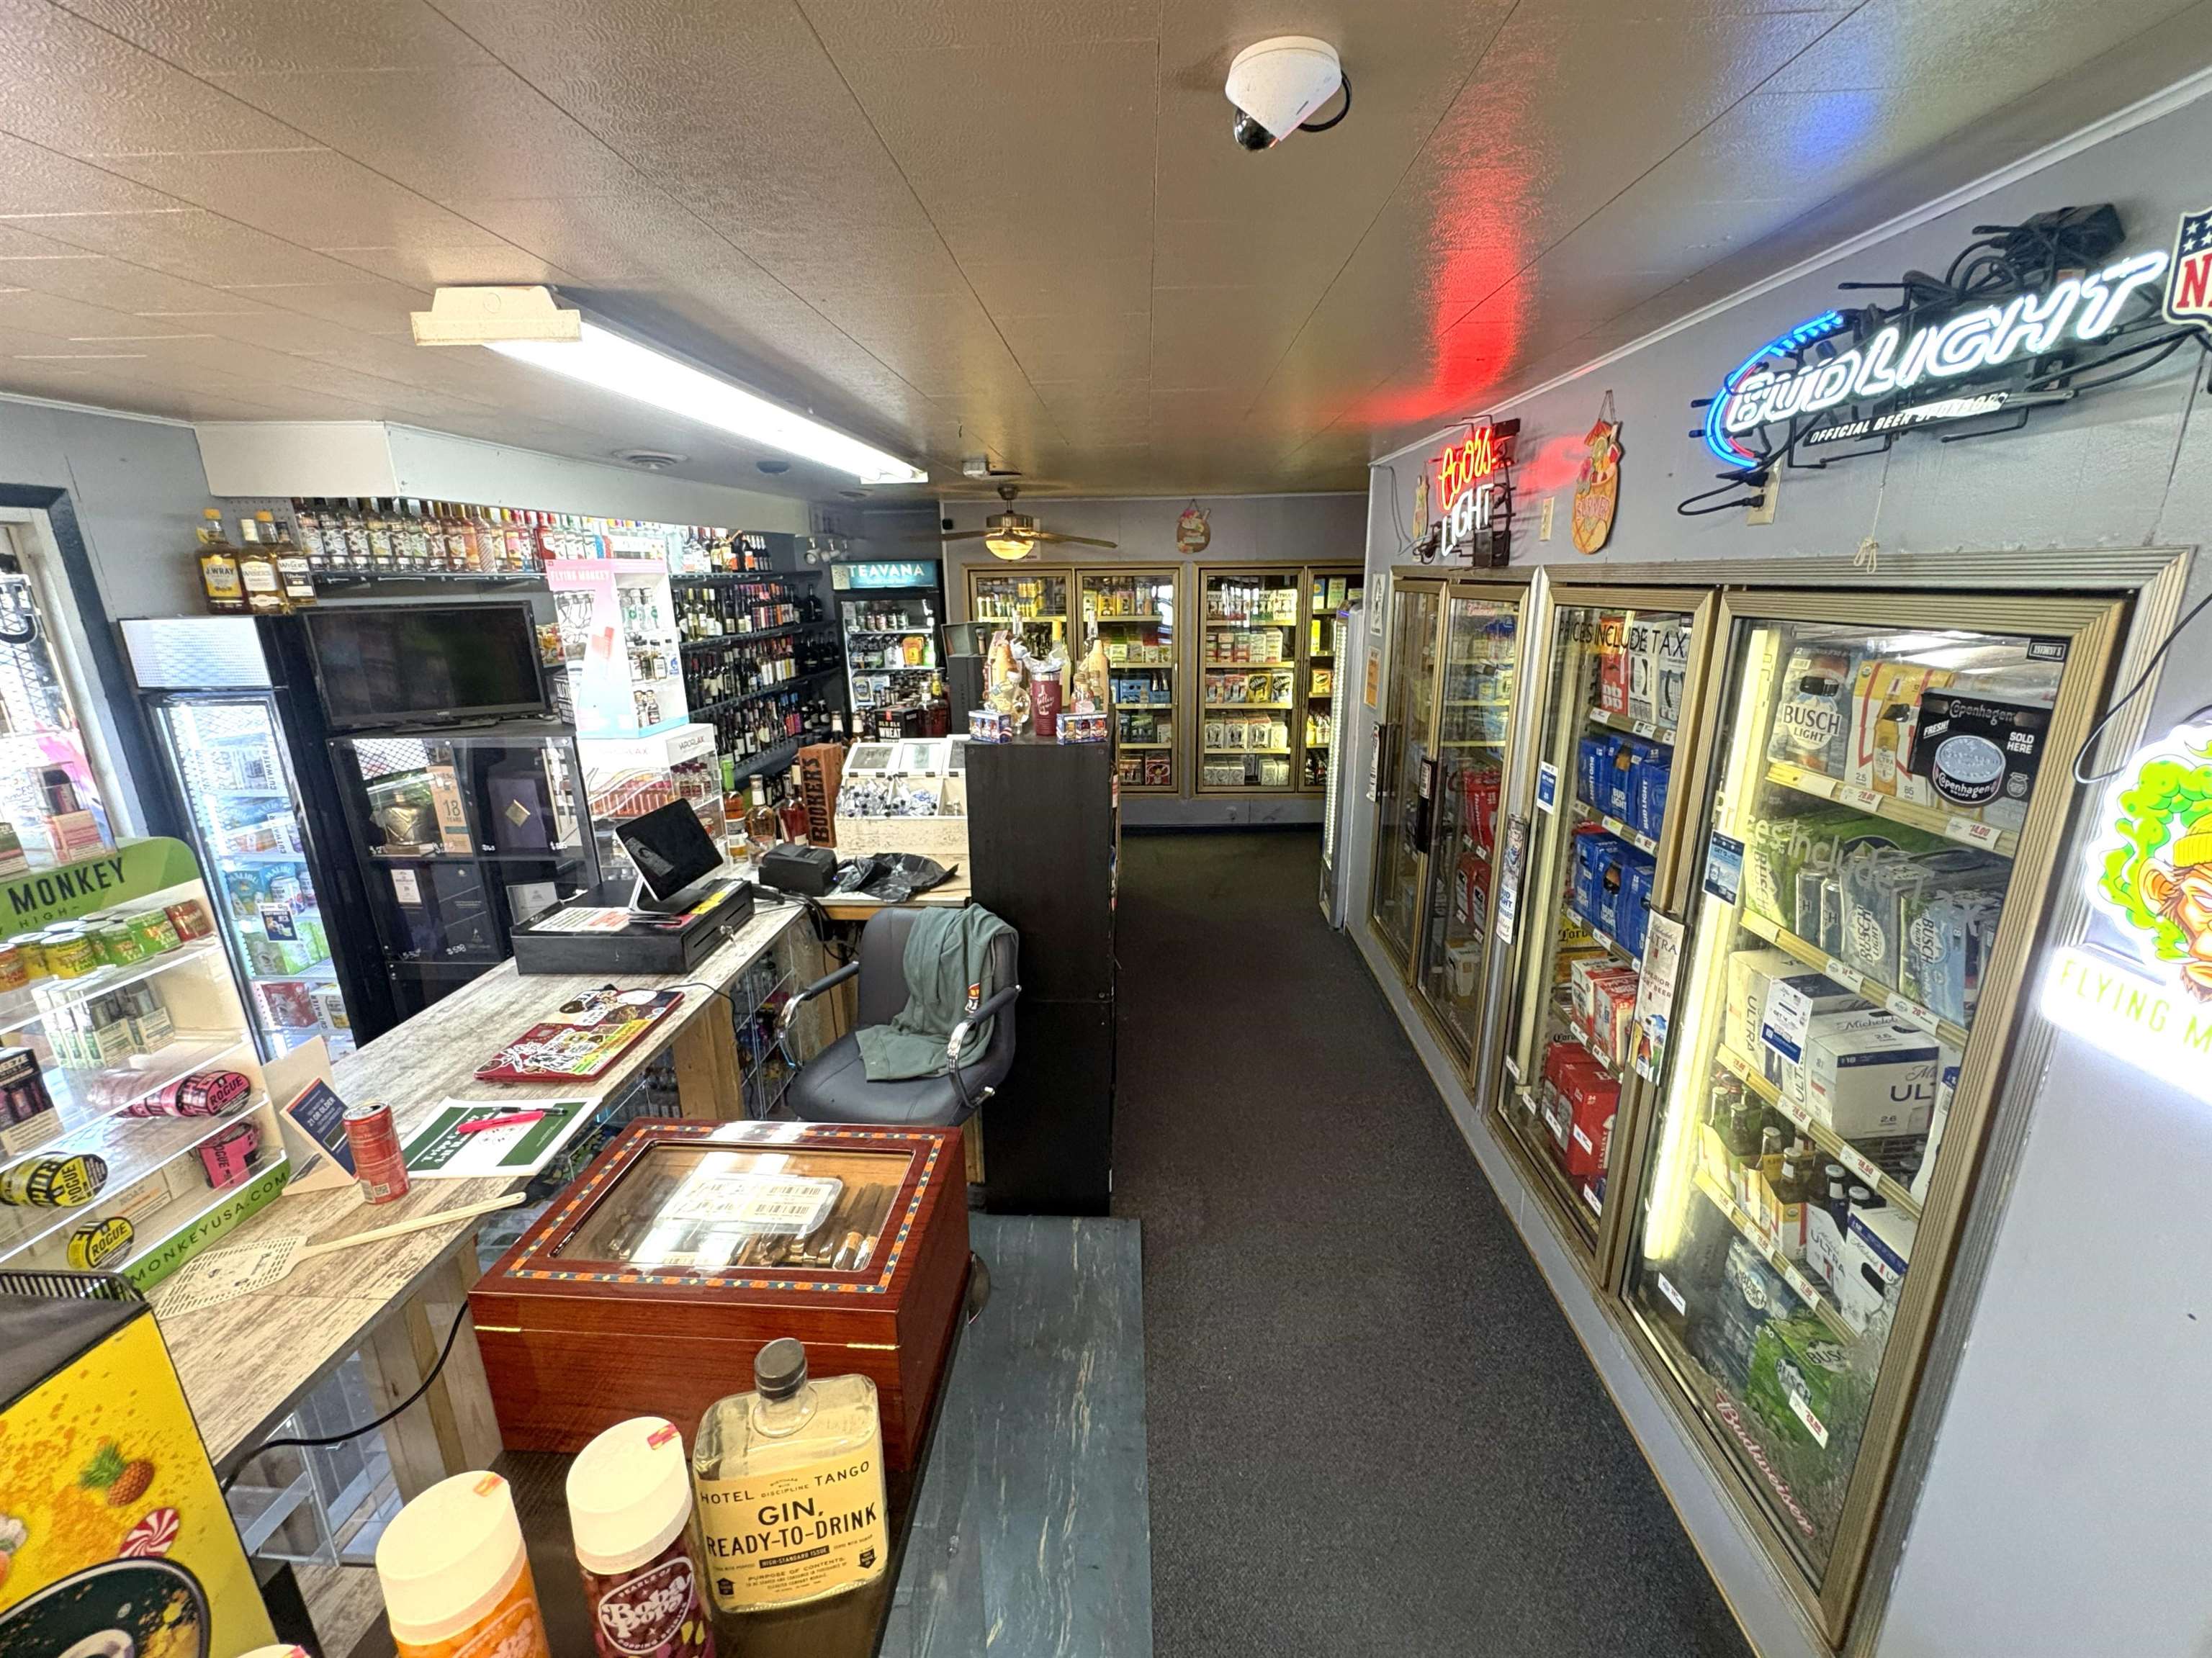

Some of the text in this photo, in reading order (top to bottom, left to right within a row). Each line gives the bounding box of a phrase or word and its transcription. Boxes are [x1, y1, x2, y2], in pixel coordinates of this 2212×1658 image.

[1727, 350, 1860, 433] BUD
[1858, 250, 2170, 397] LIGHT
[1810, 421, 1870, 444] OFFICIAL
[1438, 428, 1496, 510] Coors
[1442, 483, 1494, 557] LIGHT
[551, 570, 610, 581] FLYING MONKEY
[847, 564, 925, 577] TEAVANA
[1559, 620, 1687, 658] PRICES INCLUDE TAX
[1784, 706, 1841, 735] BUSCH
[1949, 700, 2015, 725] Copenhagen
[878, 727, 902, 738] WHEAT
[1794, 727, 1826, 742] LIGHT
[1923, 721, 1950, 736] FRESH!
[2009, 731, 2035, 744] SOLD
[2007, 742, 2033, 754] HERE
[1938, 773, 1991, 798] Copenhagen
[443, 800, 461, 817] 18
[7, 857, 126, 915] MONKEY
[1921, 916, 1935, 965] BUSCH
[1653, 983, 1672, 999] BEER
[2059, 959, 2172, 1034] FLYING
[1747, 995, 1758, 1052] ULTRA
[1845, 1016, 1898, 1031] Michelob
[209, 1075, 244, 1107] ROGUE
[62, 1163, 85, 1204] ROGUE
[91, 1222, 128, 1257] ROGUE
[1810, 1228, 1846, 1278] ULTRA
[1775, 1359, 1813, 1405] BUSCH
[814, 1461, 870, 1487] TANGO
[1715, 1387, 1815, 1538] Budweiser
[700, 1490, 754, 1505] HOTEL
[760, 1484, 809, 1498] DISCIPLINE
[757, 1497, 824, 1526] GIN,
[706, 1502, 877, 1557] READY-TO-DRINK
[761, 1547, 828, 1567] HIGH-STANDARD ISSUE
[748, 1570, 786, 1581] PURPOSE
[601, 1572, 693, 1631] Boba
[617, 1592, 684, 1639] Pops
[618, 1639, 658, 1649] POPPING
